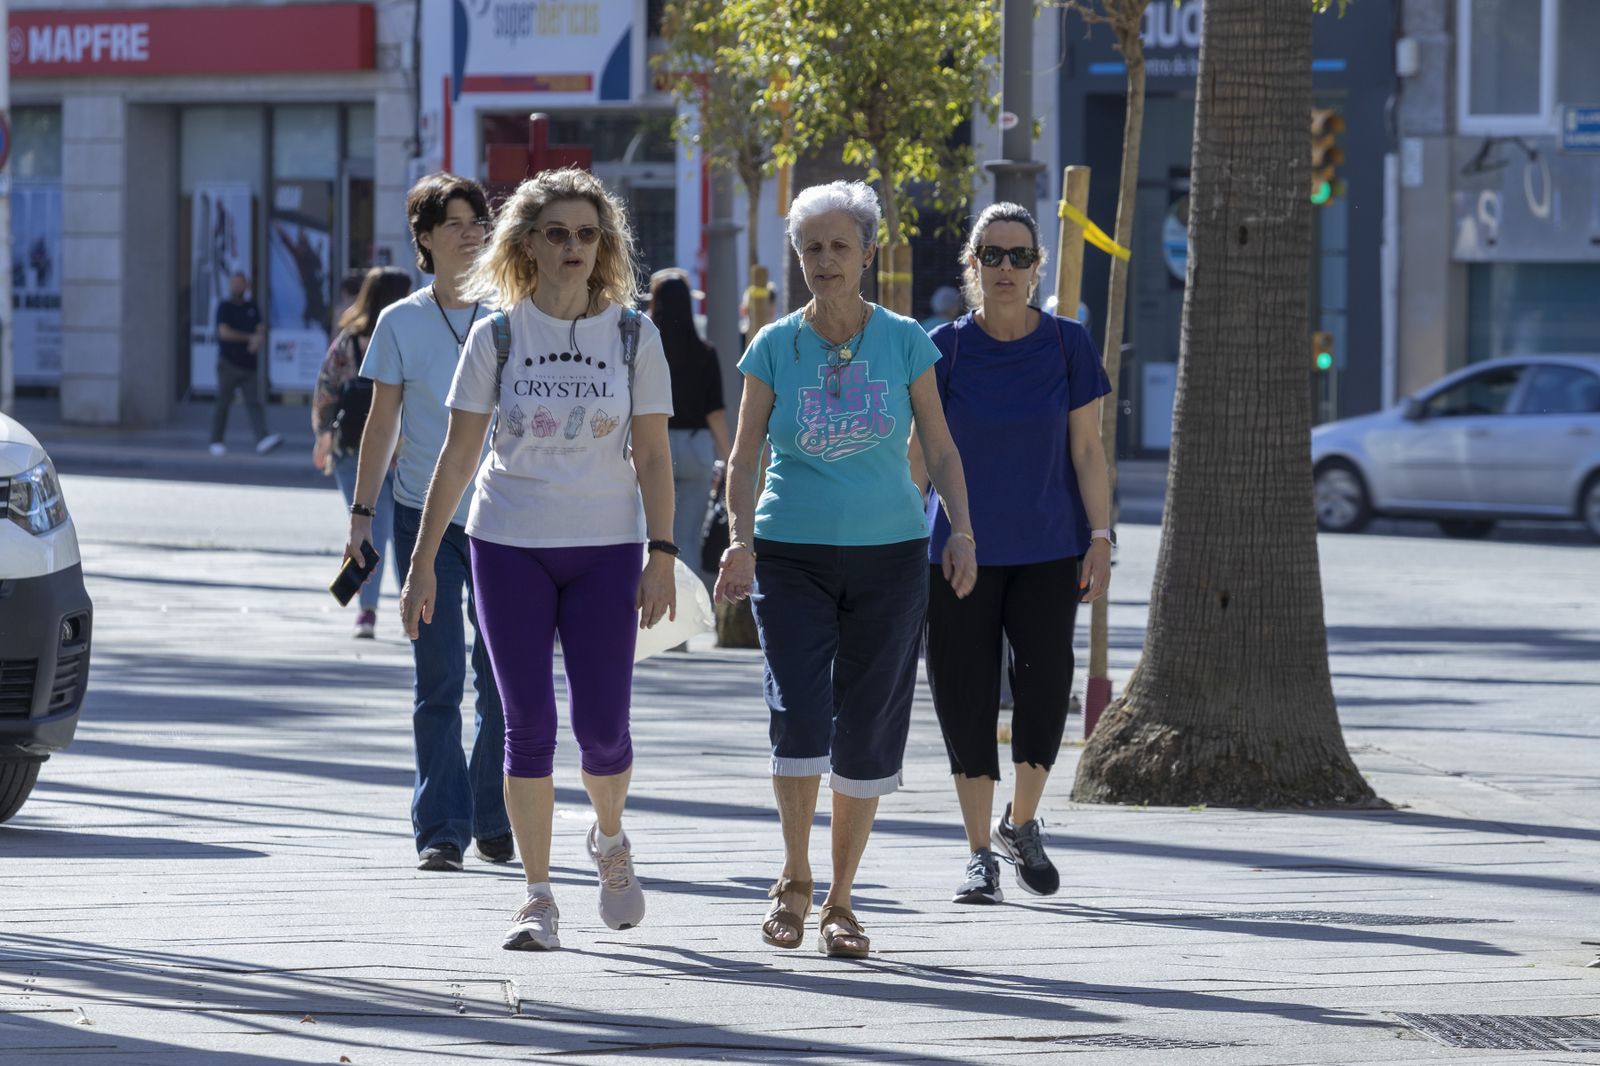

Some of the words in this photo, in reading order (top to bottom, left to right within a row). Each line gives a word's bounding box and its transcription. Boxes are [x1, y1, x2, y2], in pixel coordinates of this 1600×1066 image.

[28, 23, 149, 63] MAPFRE
[825, 365, 865, 385] THE
[514, 379, 614, 398] CRYSTAL
[803, 383, 885, 415] BEST
